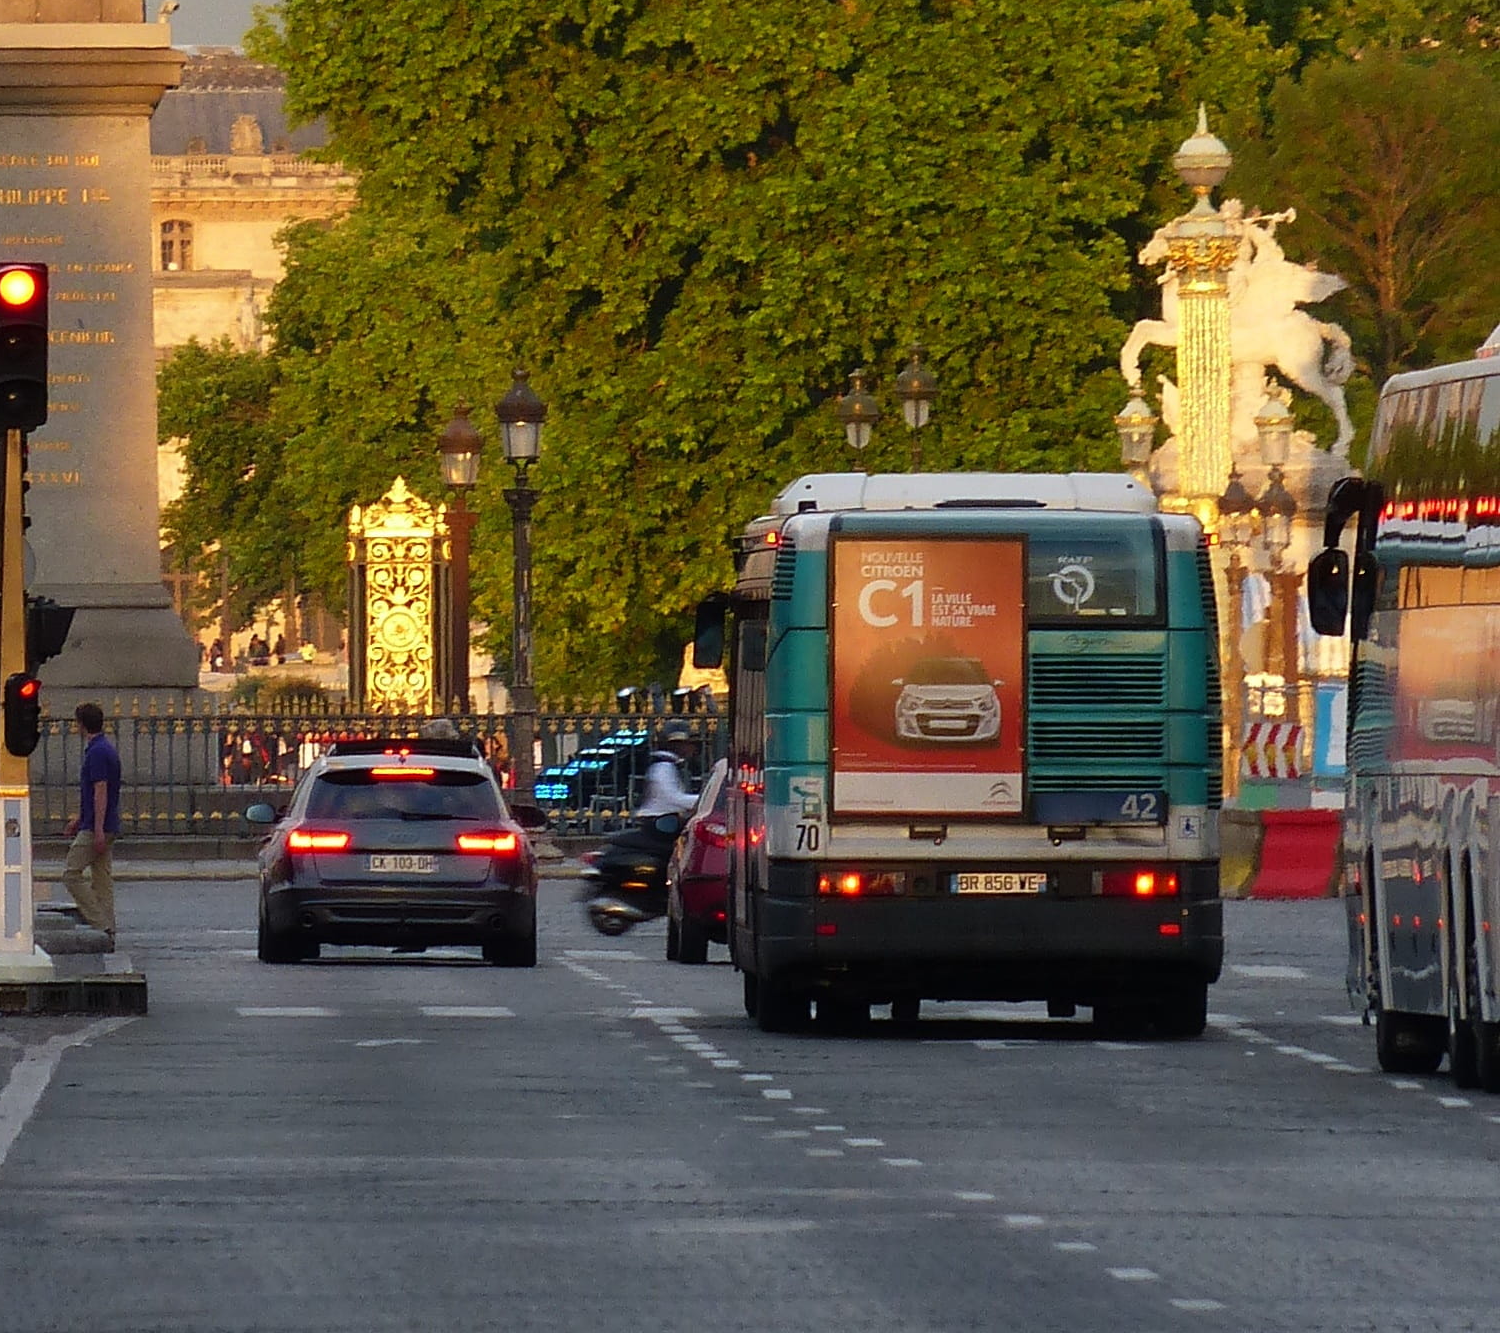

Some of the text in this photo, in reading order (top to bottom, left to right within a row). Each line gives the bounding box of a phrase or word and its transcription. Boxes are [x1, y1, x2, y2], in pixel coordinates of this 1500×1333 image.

[860, 551, 924, 564] NOUVELLE
[858, 579, 925, 627] C1
[931, 593, 973, 604] LA VILLE
[931, 605, 950, 616] EST
[951, 605, 965, 616] SA
[1121, 793, 1159, 820] 42
[795, 824, 819, 852] 70
